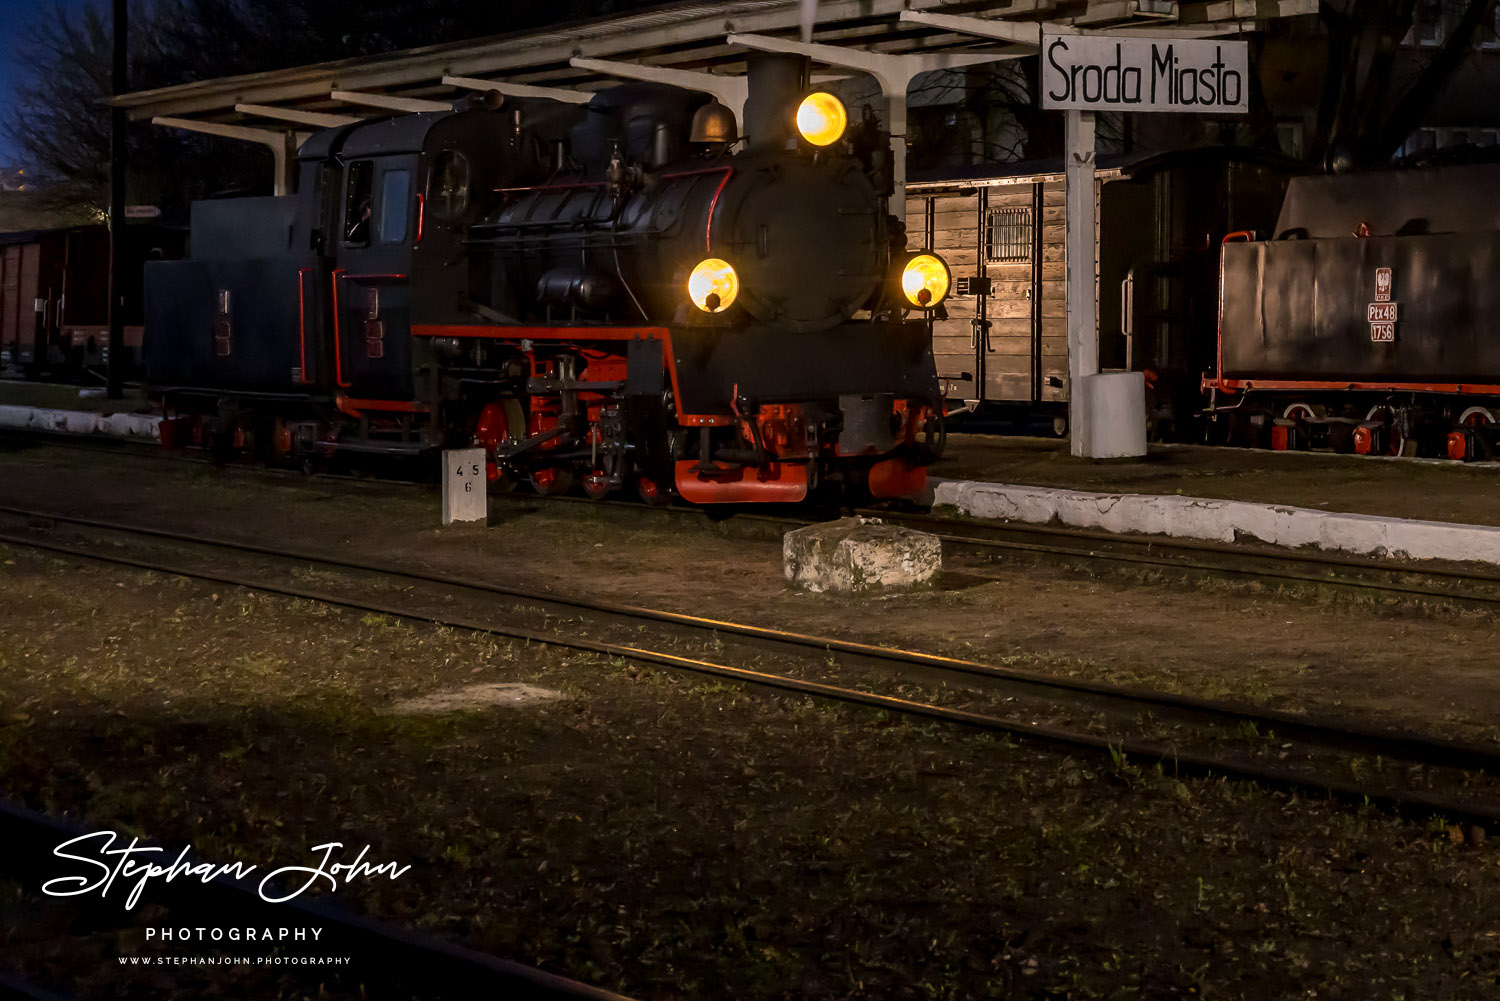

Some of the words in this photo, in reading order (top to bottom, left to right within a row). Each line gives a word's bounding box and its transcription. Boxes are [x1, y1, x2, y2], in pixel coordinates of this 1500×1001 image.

[1048, 36, 1142, 104] Środa
[1151, 43, 1242, 106] Miasto
[1369, 305, 1395, 320] Ptx48
[1372, 324, 1392, 340] 1756
[456, 465, 463, 477] 4
[472, 464, 479, 476] 5
[464, 482, 472, 493] 6
